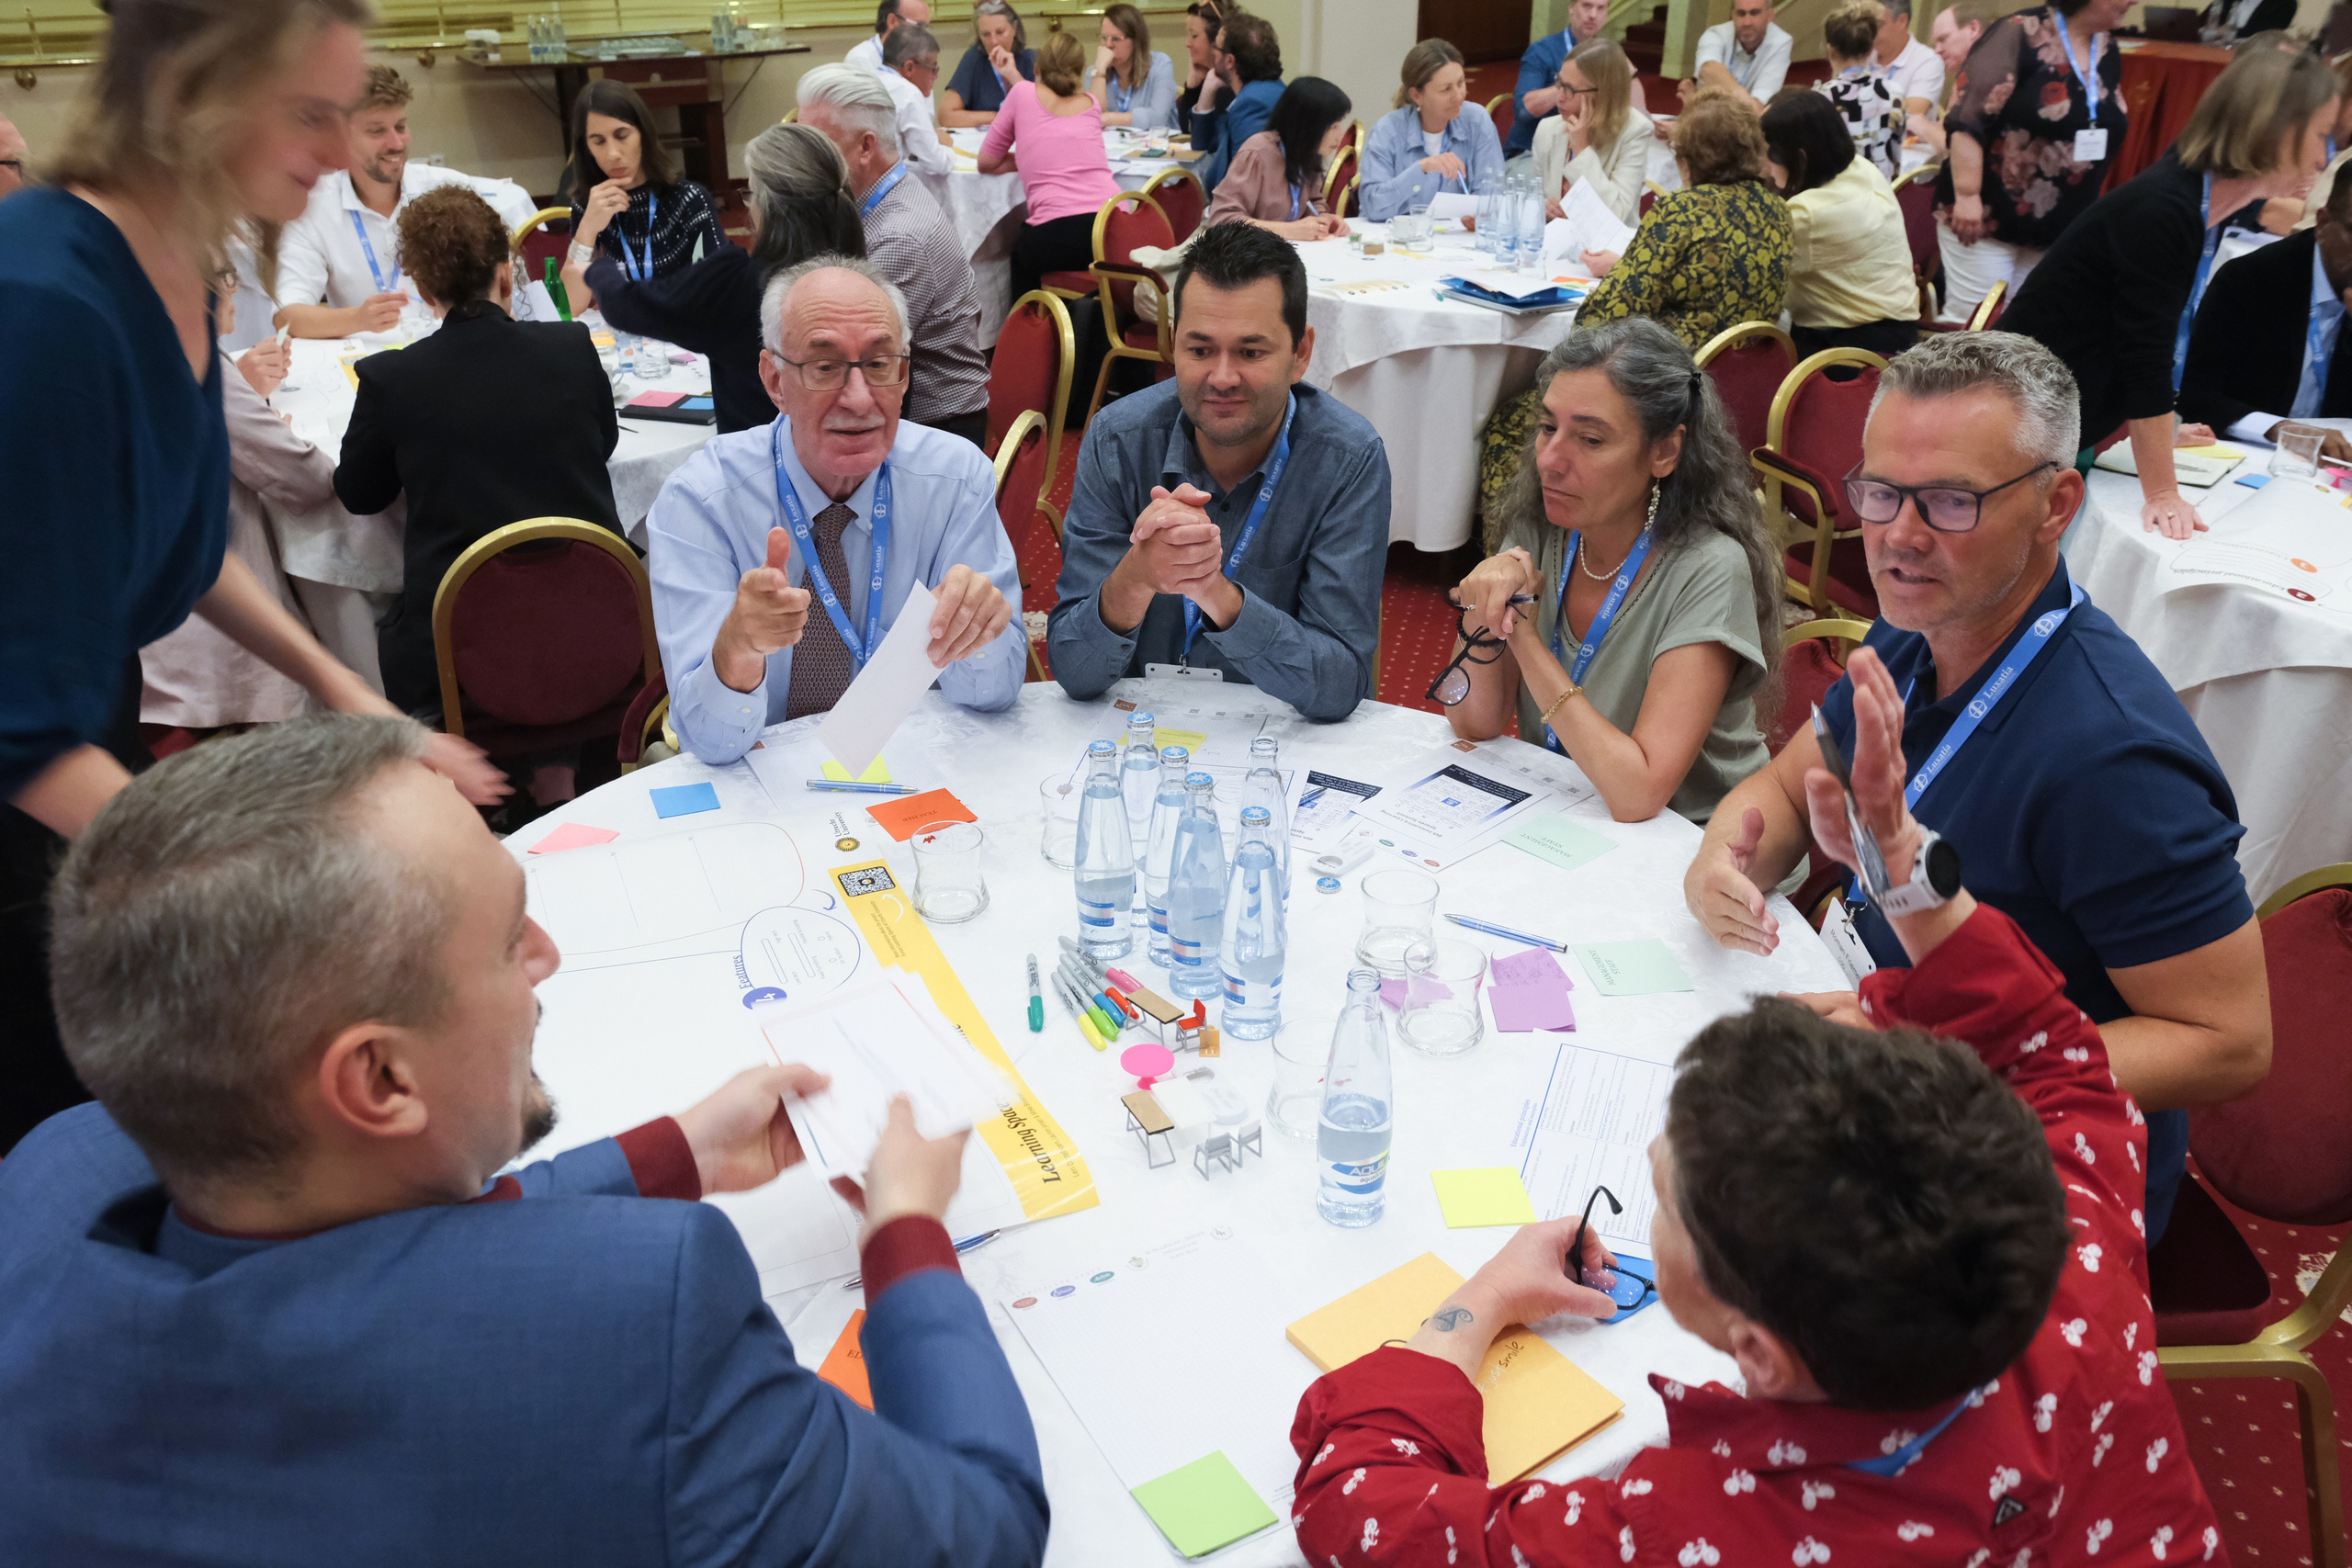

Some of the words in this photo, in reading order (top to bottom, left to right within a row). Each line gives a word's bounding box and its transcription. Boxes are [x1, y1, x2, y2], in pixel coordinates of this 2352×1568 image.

[1269, 458, 1283, 486] Luxatia
[786, 494, 799, 523] Luxatia
[1237, 525, 1253, 552] Luxatia
[874, 545, 883, 573] Luxatia
[2174, 568, 2223, 576] principles
[811, 564, 828, 592] Luxatia
[2224, 572, 2286, 592] Educational
[1600, 593, 1621, 620] Luxatia
[842, 627, 858, 653] Luxatia
[1983, 665, 2014, 699] Luxatia
[1926, 743, 1951, 773] Luxatia
[829, 818, 842, 838] Utrecht
[835, 812, 851, 836] University
[902, 810, 939, 822] TEACHER
[1520, 833, 1573, 858] MANAGEMENT
[1540, 837, 1565, 848] STAFF
[1830, 929, 1845, 955] Roman
[733, 954, 752, 990] Features
[1589, 949, 1616, 986] MANAGEMENT
[1604, 958, 1621, 975] STAFF
[1510, 1121, 1524, 1147] Educational
[1518, 1099, 1531, 1122] principles
[1016, 1128, 1062, 1184] Learning
